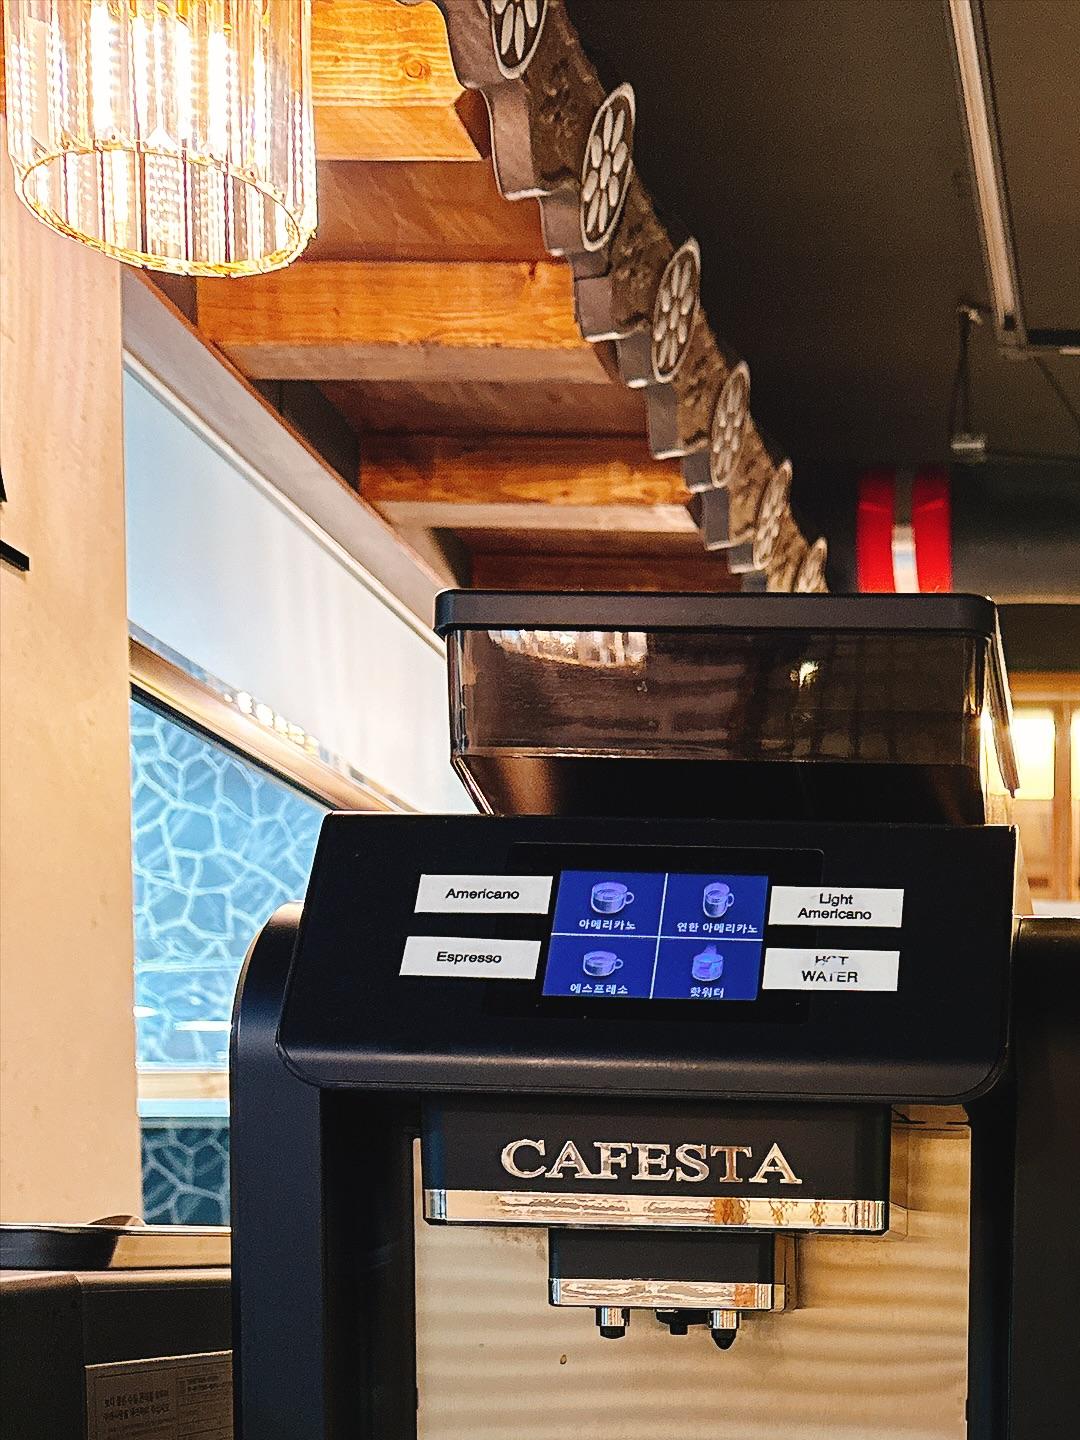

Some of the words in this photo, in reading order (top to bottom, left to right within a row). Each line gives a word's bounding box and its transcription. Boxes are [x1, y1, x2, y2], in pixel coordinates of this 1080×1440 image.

[445, 888, 520, 900] Americano
[819, 893, 854, 907] Light
[797, 907, 872, 920] Americano
[578, 919, 636, 931] 아메리카노
[677, 921, 700, 933] 연한
[702, 922, 758, 934] 아메리카노
[436, 951, 502, 965] Espresso
[815, 955, 849, 966] HT
[569, 983, 629, 995] 에스프레소
[690, 986, 725, 998] 핫워터
[500, 1138, 803, 1185] CAFESTA
